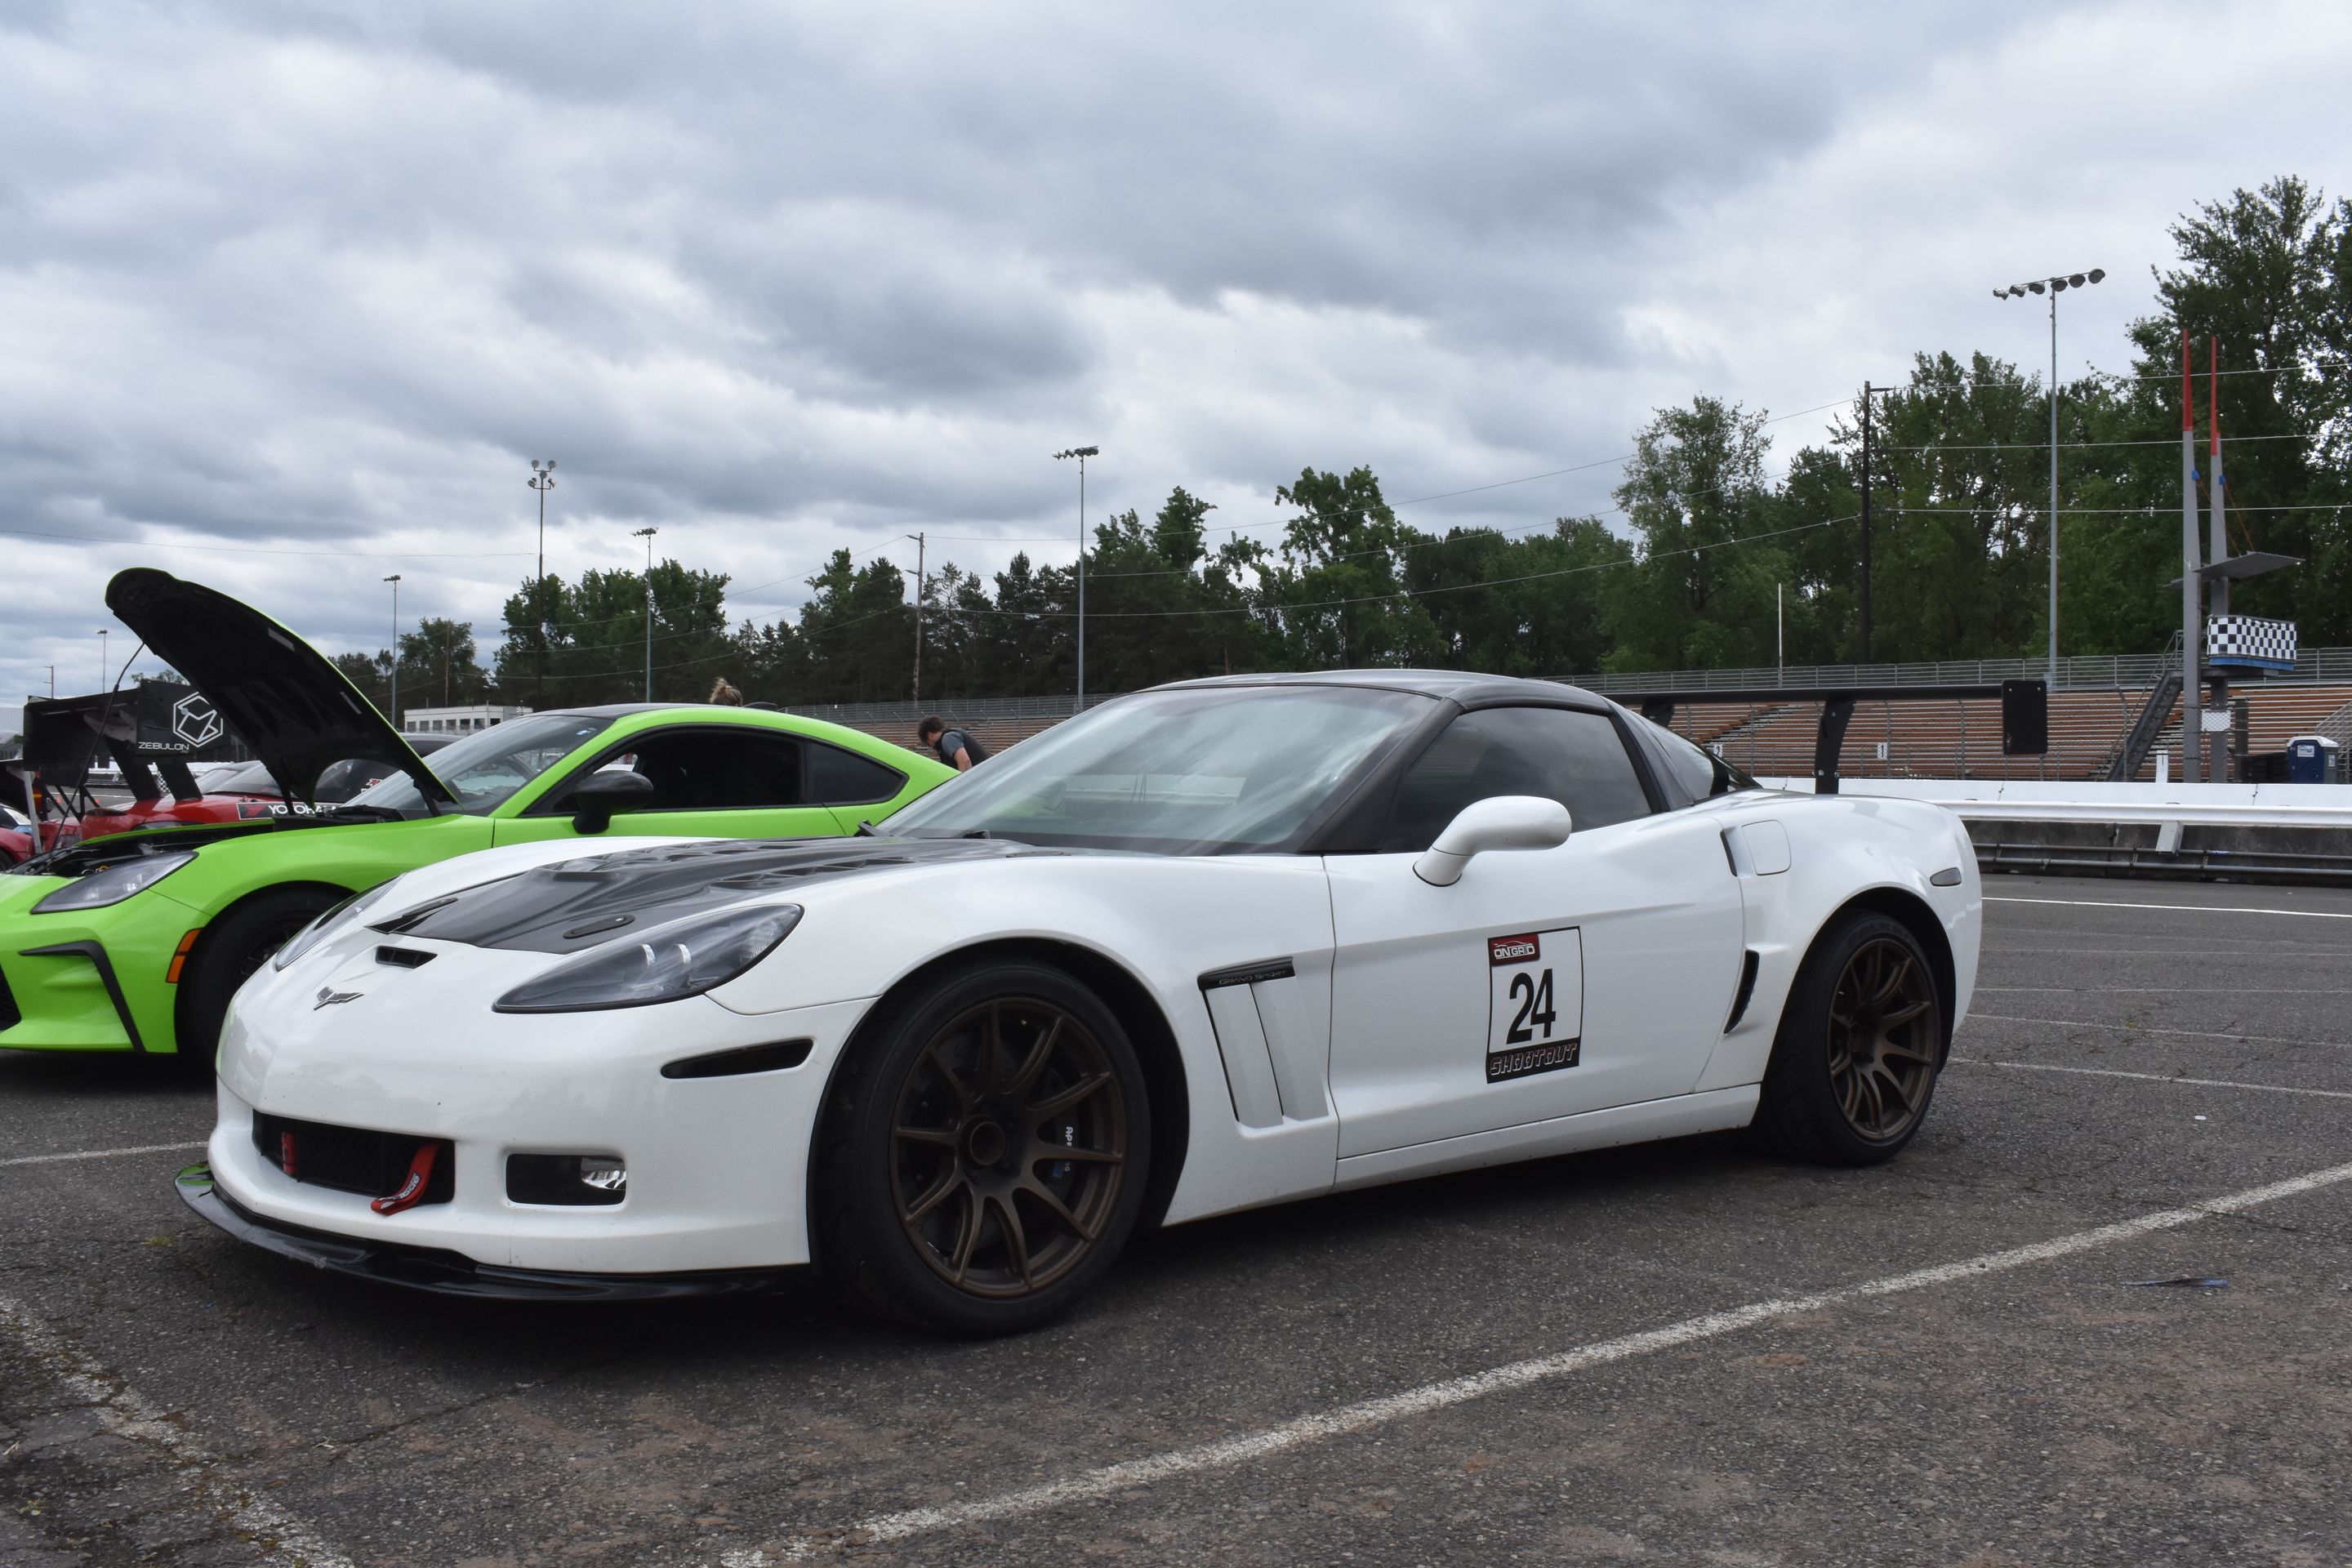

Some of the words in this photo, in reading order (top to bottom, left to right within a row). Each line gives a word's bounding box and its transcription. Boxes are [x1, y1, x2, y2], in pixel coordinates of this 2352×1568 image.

[138, 742, 189, 751] ZEBULON
[1506, 969, 1557, 1045] 24
[1490, 1043, 1578, 1076] SHOOTOUT
